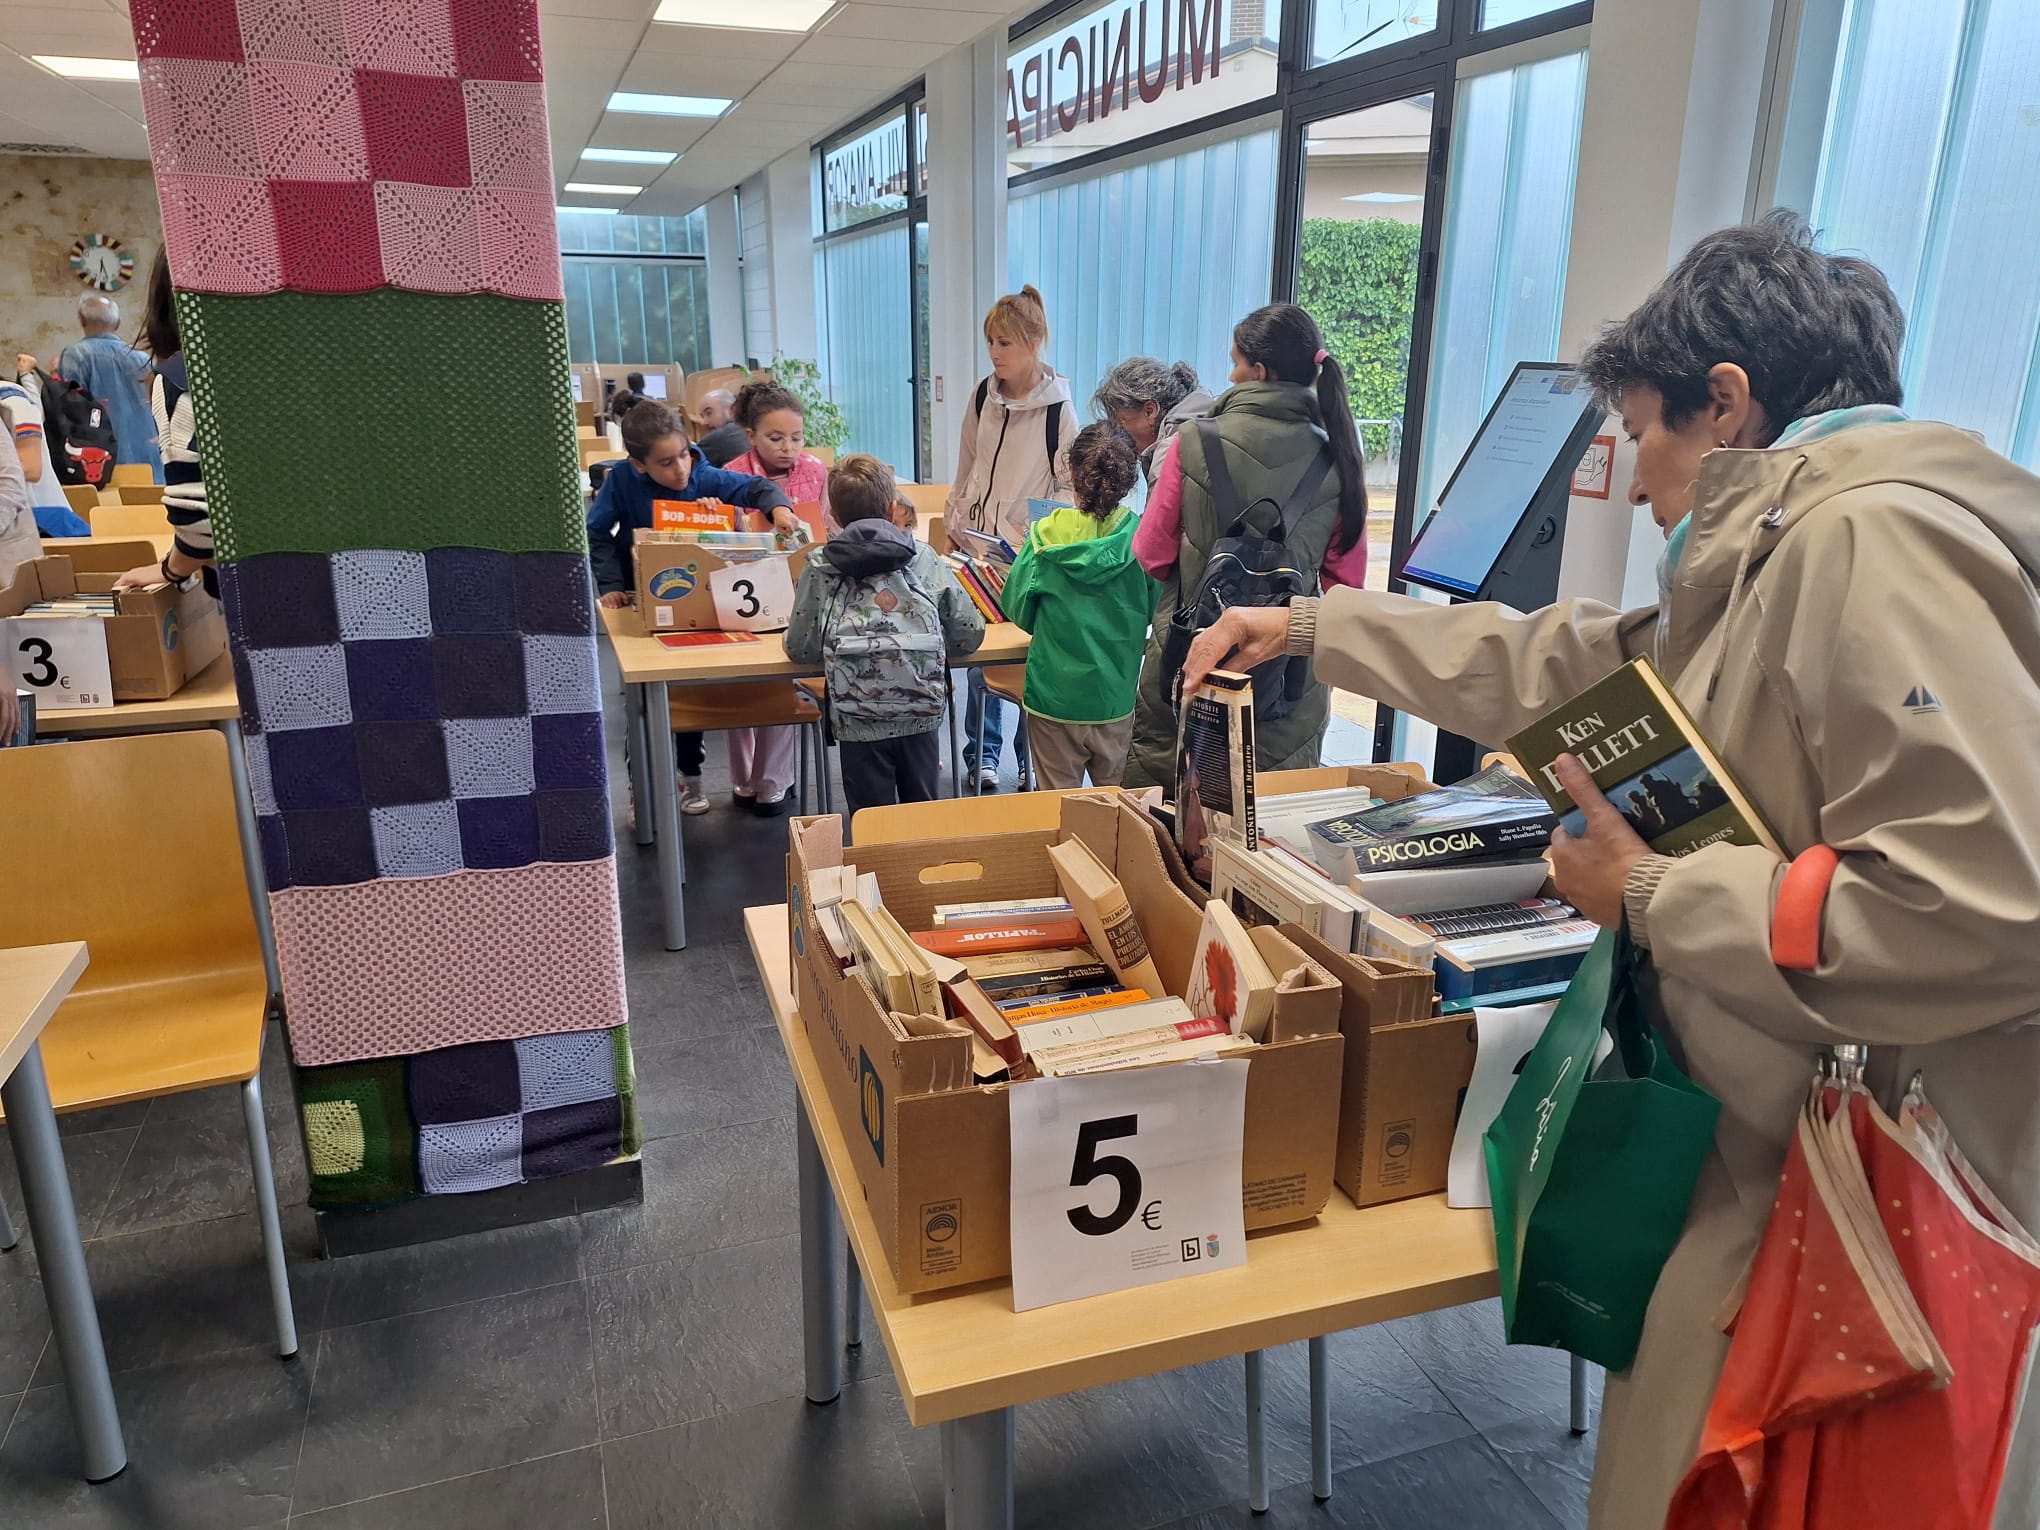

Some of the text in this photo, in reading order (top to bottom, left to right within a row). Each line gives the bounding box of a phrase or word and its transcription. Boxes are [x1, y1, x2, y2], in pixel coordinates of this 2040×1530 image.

[661, 510, 685, 523] BOB
[1539, 714, 1660, 793] FLLETT
[1368, 831, 1485, 865] PSICOLOGIA
[1108, 930, 1118, 940] EL
